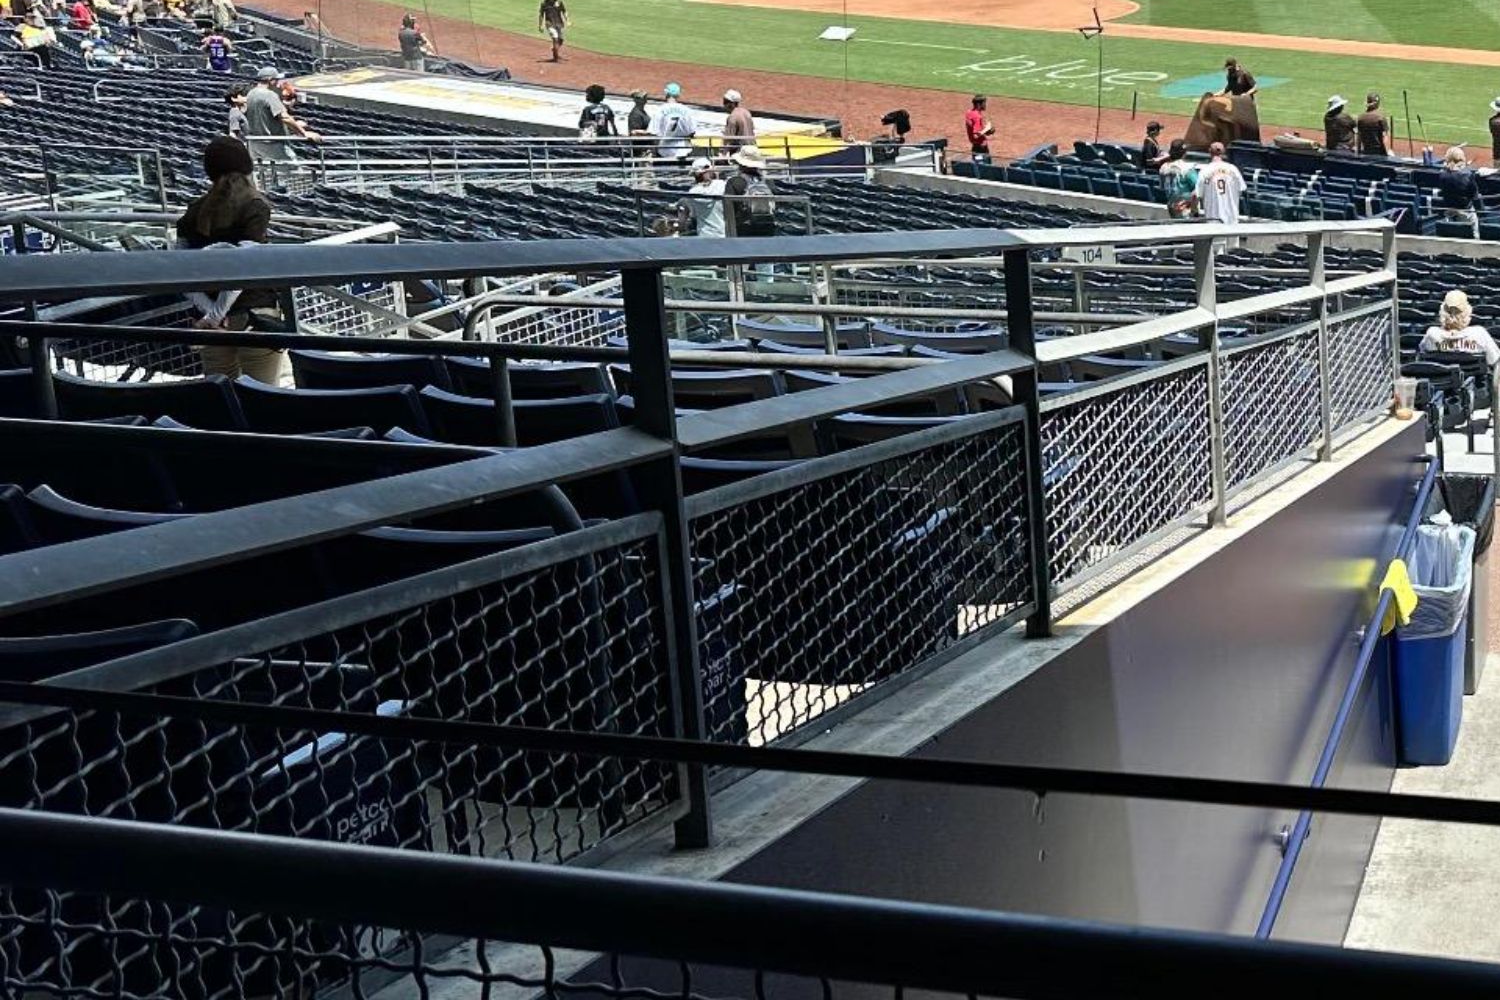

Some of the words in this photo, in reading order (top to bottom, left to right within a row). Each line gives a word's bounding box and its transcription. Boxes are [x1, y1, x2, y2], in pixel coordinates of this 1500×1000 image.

[957, 54, 1168, 85] blue
[670, 116, 681, 132] 7
[1217, 179, 1226, 195] 9
[1082, 246, 1103, 263] 104
